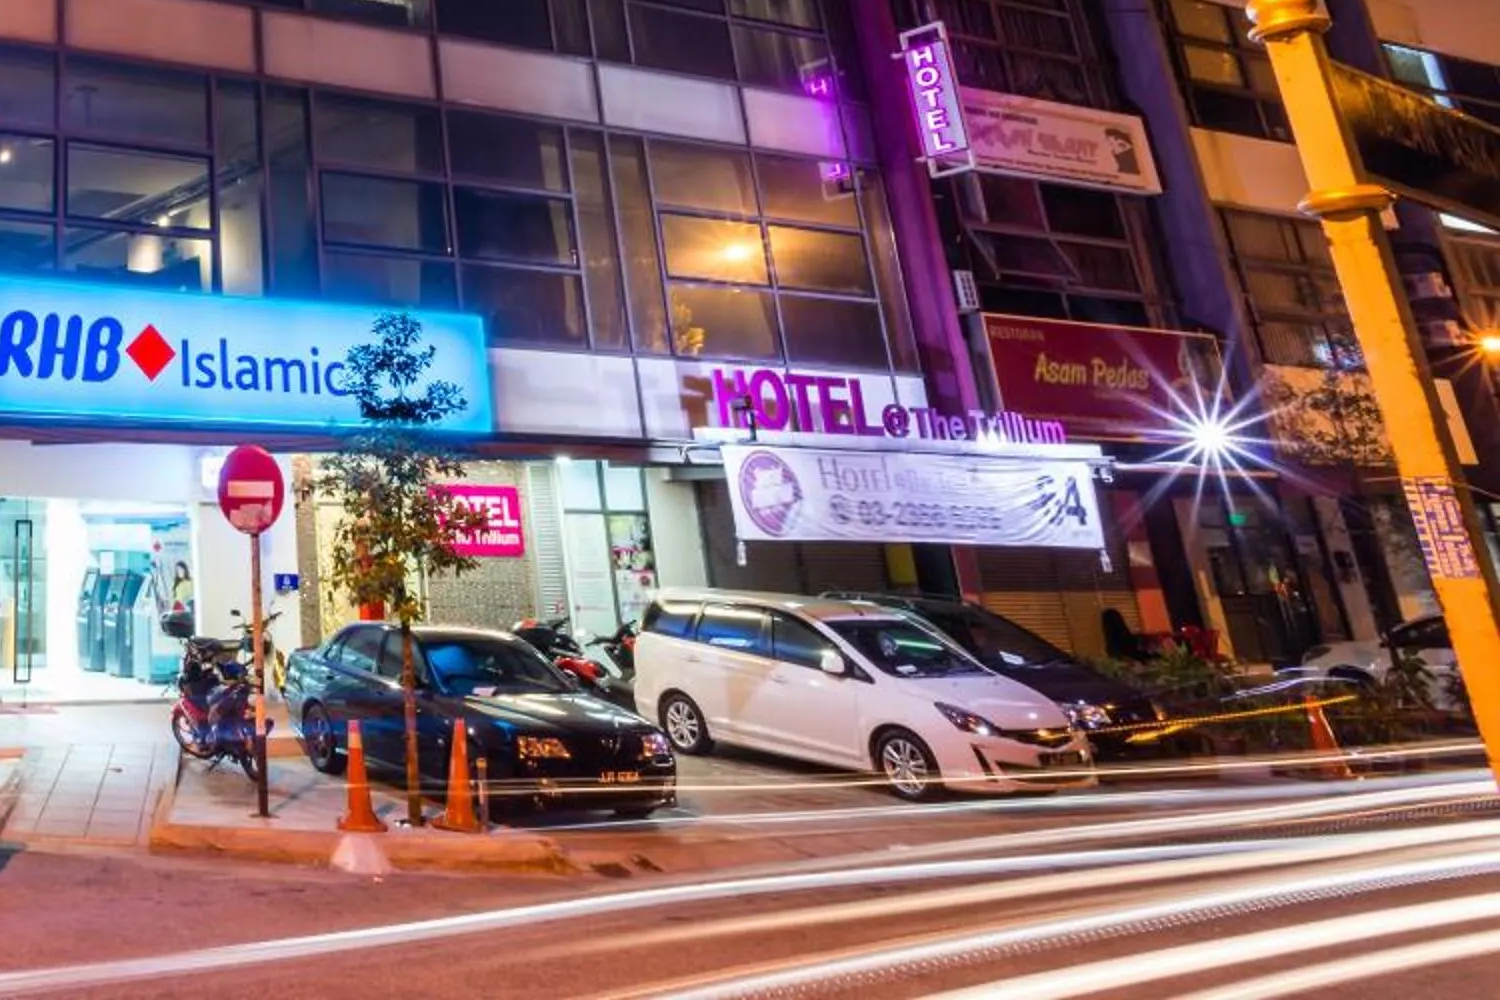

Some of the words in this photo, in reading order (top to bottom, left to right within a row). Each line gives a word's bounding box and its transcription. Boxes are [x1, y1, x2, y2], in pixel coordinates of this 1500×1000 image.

[912, 47, 953, 150] HOTEL
[182, 338, 348, 397] Islamic
[1035, 352, 1087, 387] Asam
[1091, 357, 1149, 390] Pedas
[713, 369, 885, 436] HOTEL
[969, 408, 1066, 445] Trillium
